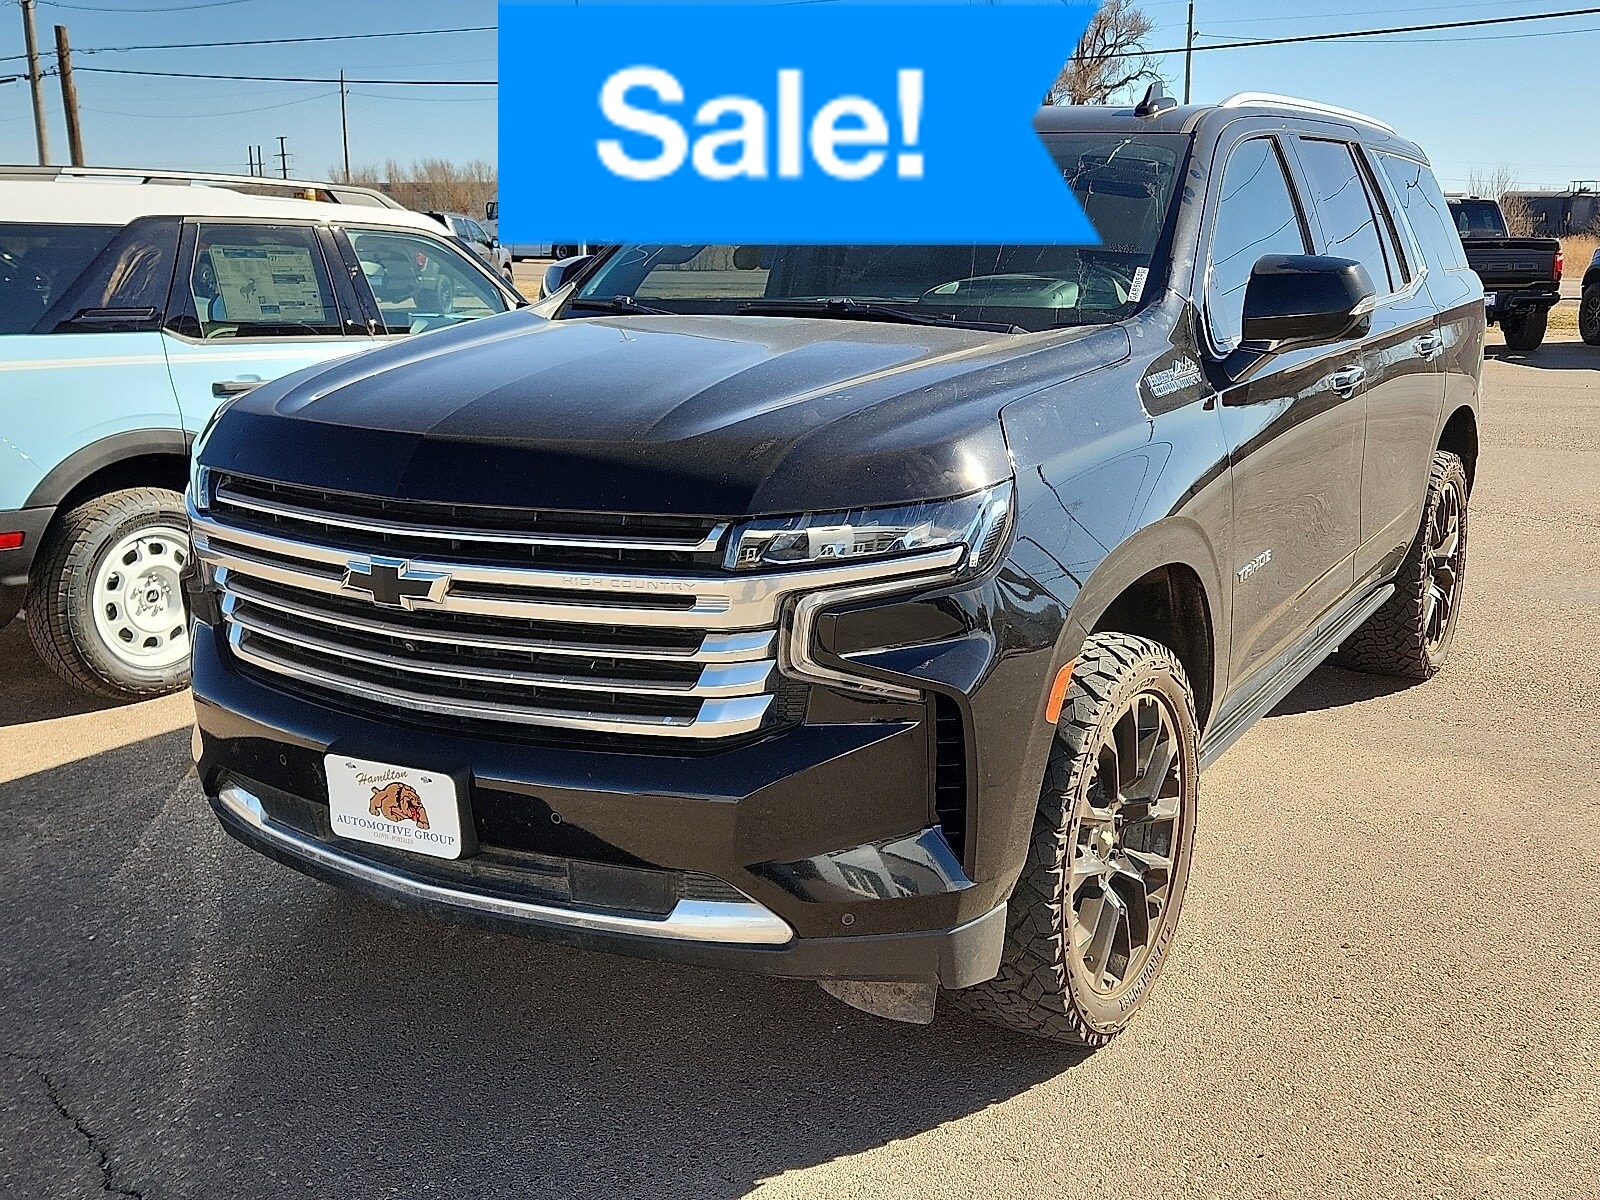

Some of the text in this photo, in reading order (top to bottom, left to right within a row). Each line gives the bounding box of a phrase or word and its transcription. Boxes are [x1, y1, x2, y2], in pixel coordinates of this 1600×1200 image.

[1236, 548, 1272, 583] TAHOE
[562, 576, 697, 591] HIGH COUNTRY
[355, 768, 409, 786] Hamilton
[336, 813, 455, 846] AUTOMOTIVE GROUP
